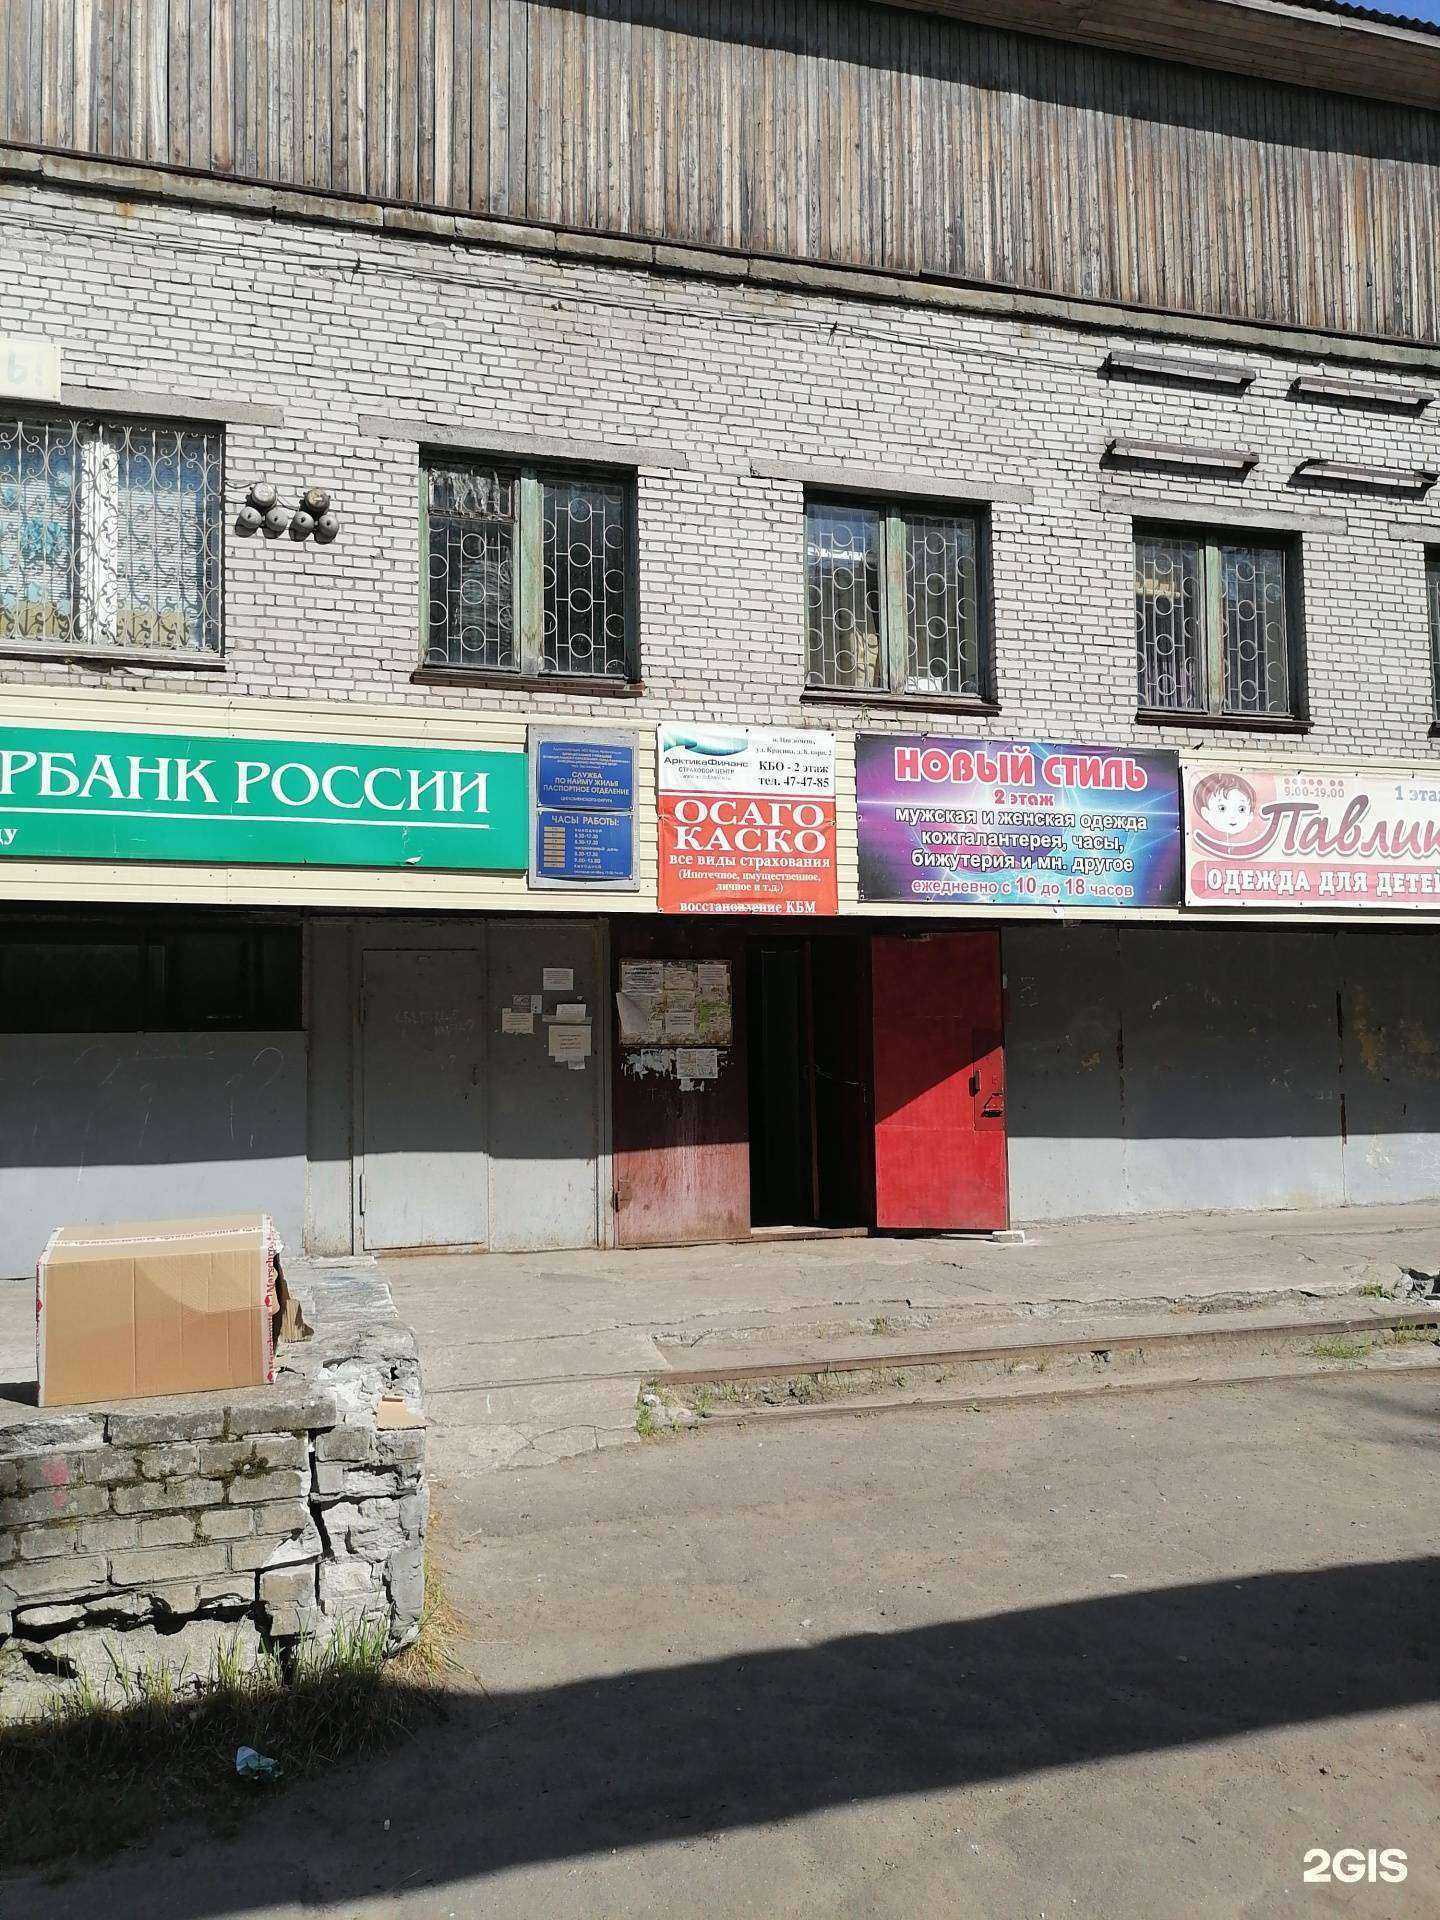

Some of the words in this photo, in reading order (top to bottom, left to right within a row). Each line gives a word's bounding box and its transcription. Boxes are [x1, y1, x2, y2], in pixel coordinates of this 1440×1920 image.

[759, 761, 784, 772] КБО
[794, 763, 799, 772] 2
[803, 764, 829, 774] этаж
[896, 747, 1035, 786] НОВЫЙ
[1044, 756, 1147, 791] СТИЛЬ
[235, 760, 490, 814] РОССИИ
[544, 784, 590, 793] ПАСПОРТНОЕ
[567, 778, 593, 786] НАЙМУ
[594, 779, 619, 787] ЖИЛЬЯ
[759, 776, 781, 786] тел.
[784, 777, 829, 788] 47-47-85
[995, 789, 1005, 805] 2
[1011, 793, 1054, 806] этаж
[1284, 786, 1345, 798] 9.00-19.00
[1394, 785, 1404, 801] 1
[1408, 790, 1440, 802] эта
[552, 815, 578, 824] ЧАСЫ
[583, 817, 619, 826] РАБОТЫ:
[674, 799, 825, 828] ОСАГО
[895, 808, 977, 825] мужская
[983, 812, 994, 824] и
[998, 812, 1075, 828] женская
[1081, 816, 1147, 831] одежда
[0, 828, 19, 846] у
[674, 826, 826, 854] КАСКО
[922, 829, 1068, 852] кожгалантерея,
[1072, 836, 1124, 852] часы,
[670, 854, 692, 864] все
[697, 855, 735, 868] виды
[740, 857, 830, 870] страхования
[912, 849, 1014, 872] бижутерия
[1021, 855, 1031, 868] и
[1037, 856, 1068, 870] мн.
[1072, 857, 1133, 875] другое
[679, 869, 740, 881] (Ипотечное,
[743, 871, 821, 882] имущественное,
[1207, 868, 1311, 895] ОДЕЖДА
[1318, 871, 1369, 895] ДЛЯ
[716, 882, 751, 891] личное
[762, 882, 784, 893] т.д.)
[912, 879, 998, 896] ежедневно
[1001, 883, 1010, 894] с
[1016, 878, 1036, 894] 10
[1041, 884, 1060, 897] до
[1066, 879, 1085, 896] 18
[1090, 884, 1134, 896] часов
[680, 902, 782, 913] восстановление
[786, 900, 816, 912] КБМ
